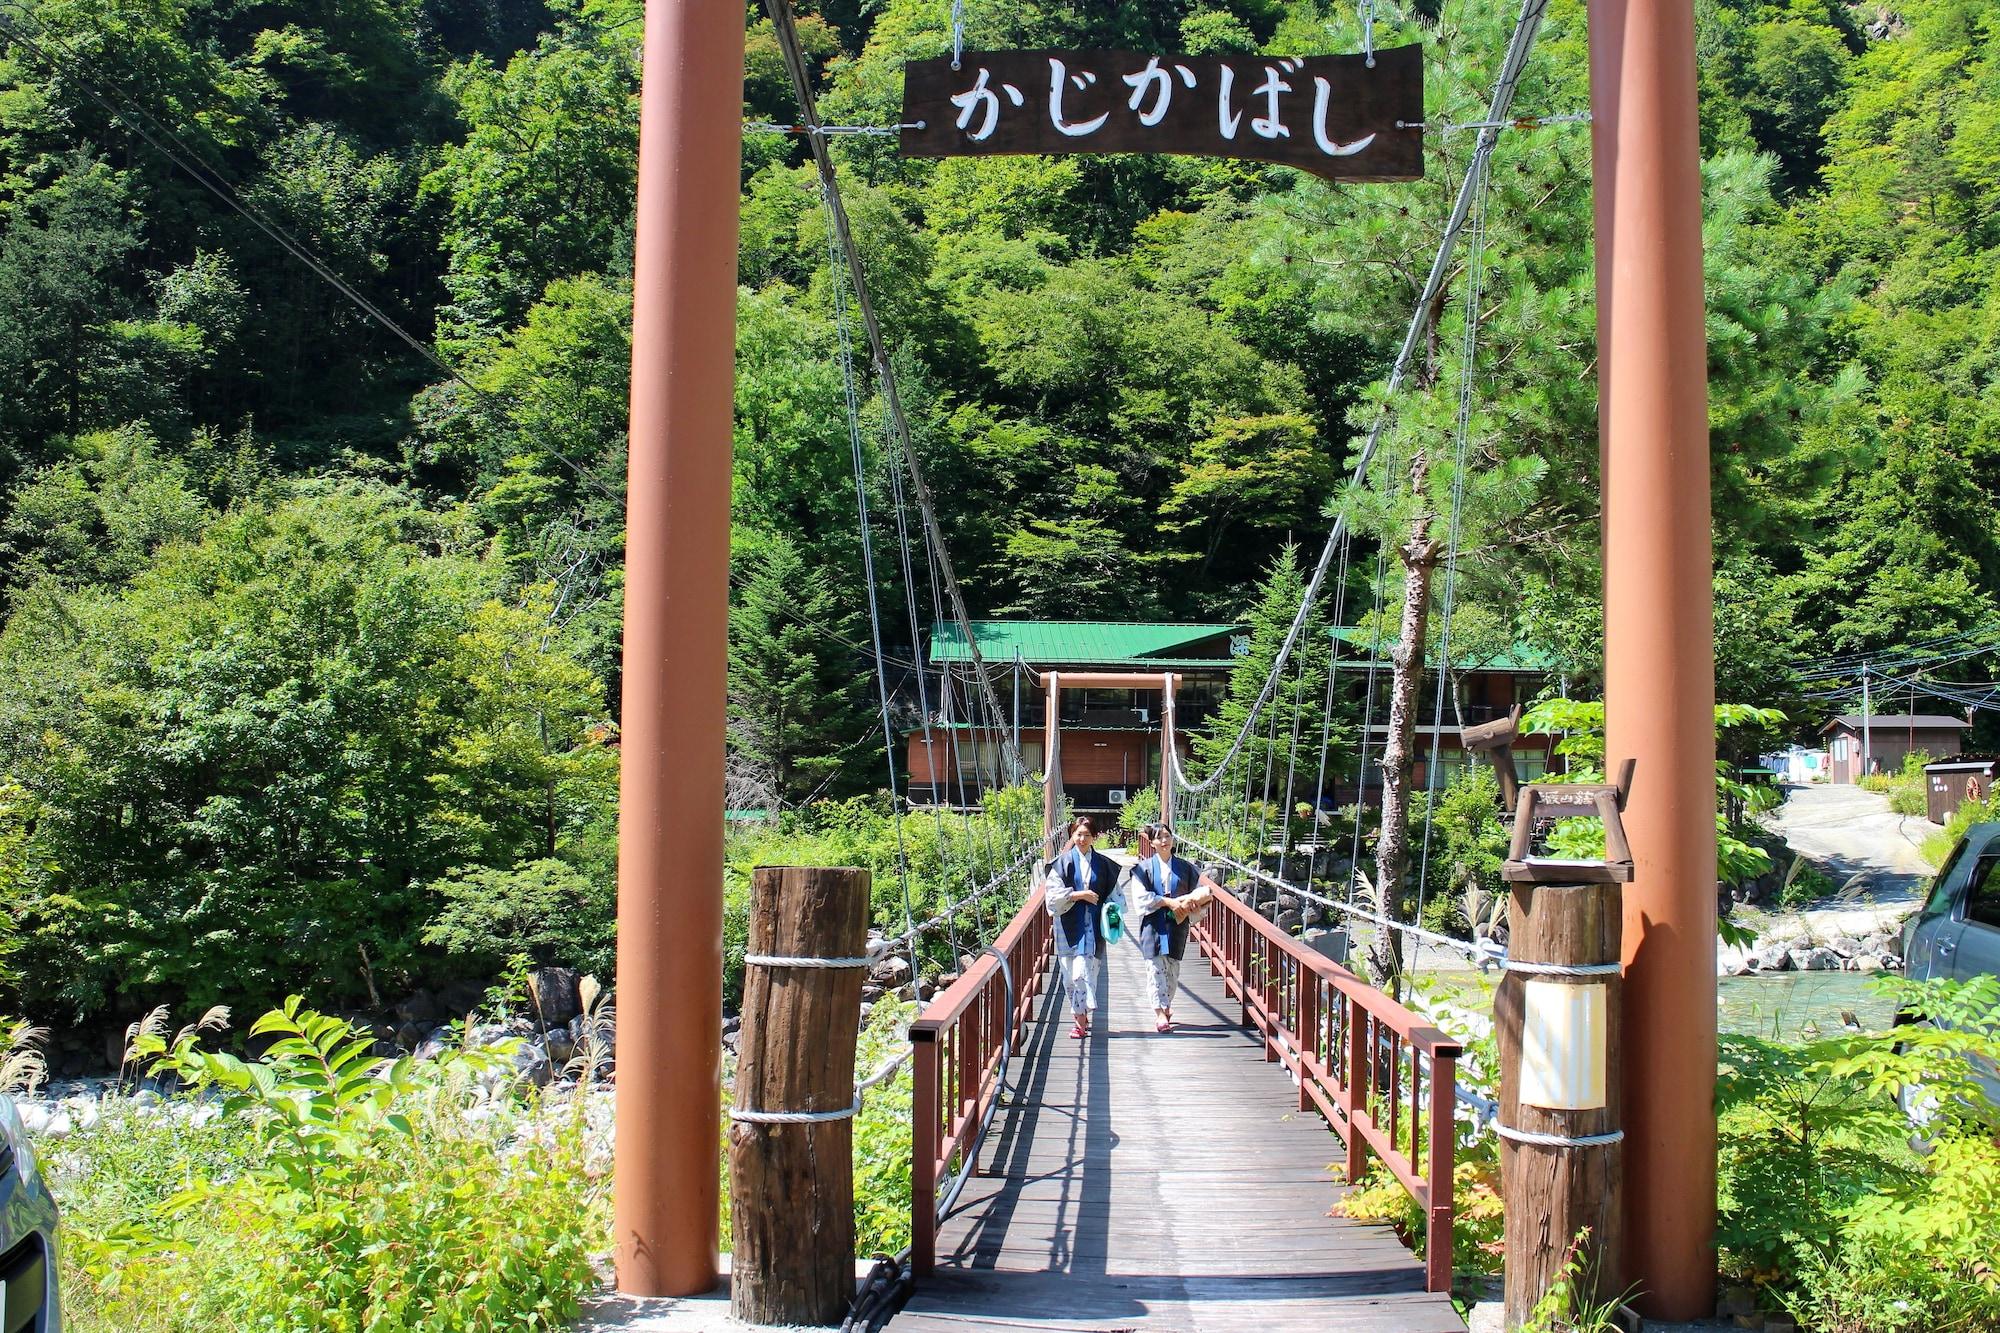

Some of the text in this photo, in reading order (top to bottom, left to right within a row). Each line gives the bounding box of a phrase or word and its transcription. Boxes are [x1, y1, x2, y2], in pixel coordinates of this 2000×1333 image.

[950, 56, 1376, 156] かじかばし
